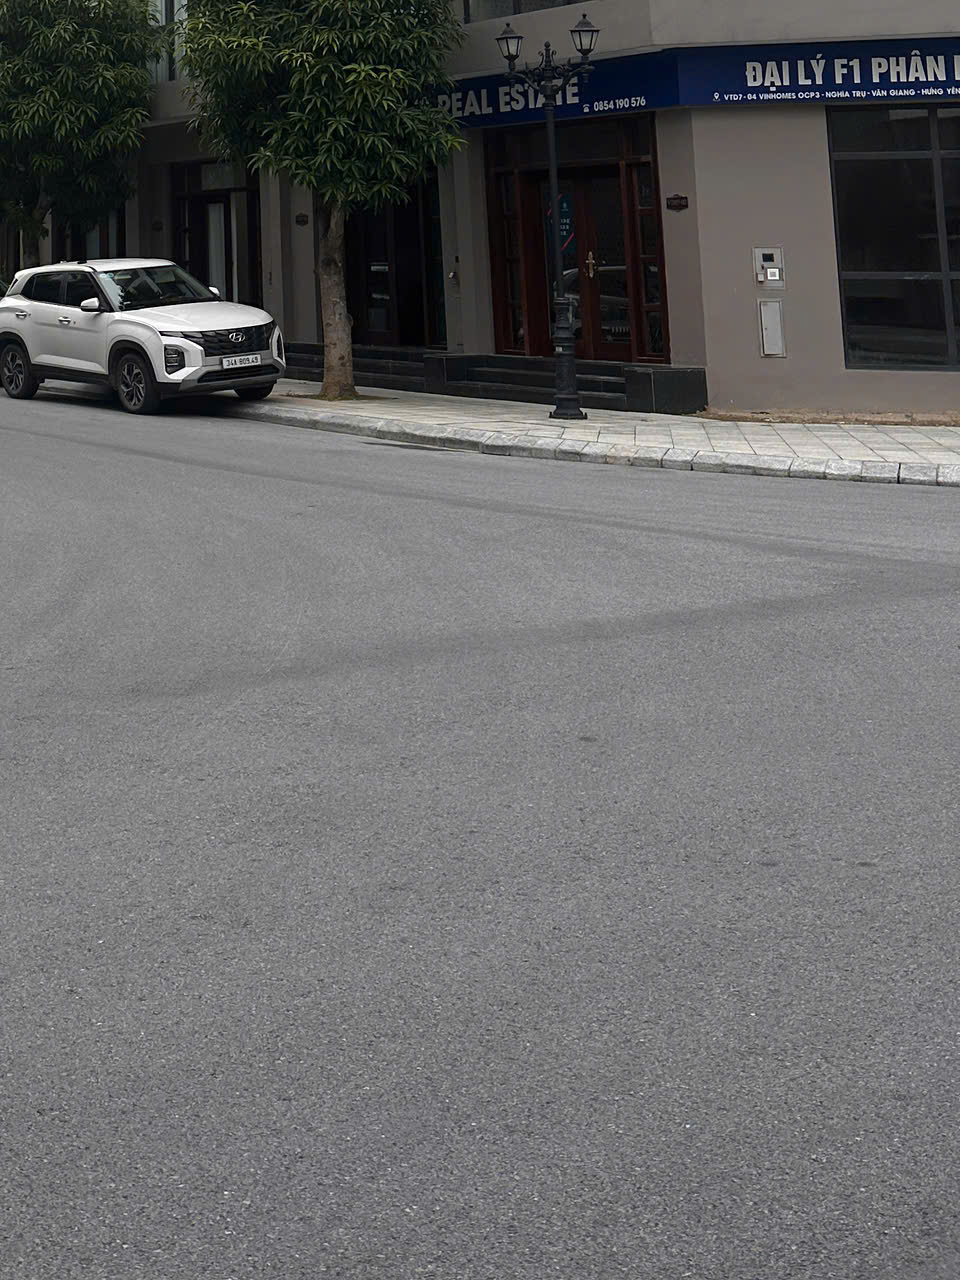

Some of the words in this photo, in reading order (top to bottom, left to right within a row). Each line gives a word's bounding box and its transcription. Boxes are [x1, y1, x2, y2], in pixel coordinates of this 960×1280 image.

[745, 59, 790, 91] ĐẠI
[797, 53, 825, 86] LÝ
[834, 58, 861, 84] F1
[871, 49, 947, 83] PHÂN
[437, 88, 493, 118] REAL
[593, 100, 615, 112] 0854
[616, 98, 630, 110] 190
[631, 96, 647, 108] 576
[758, 91, 797, 100] VINHOMES
[889, 88, 916, 97] GIANG
